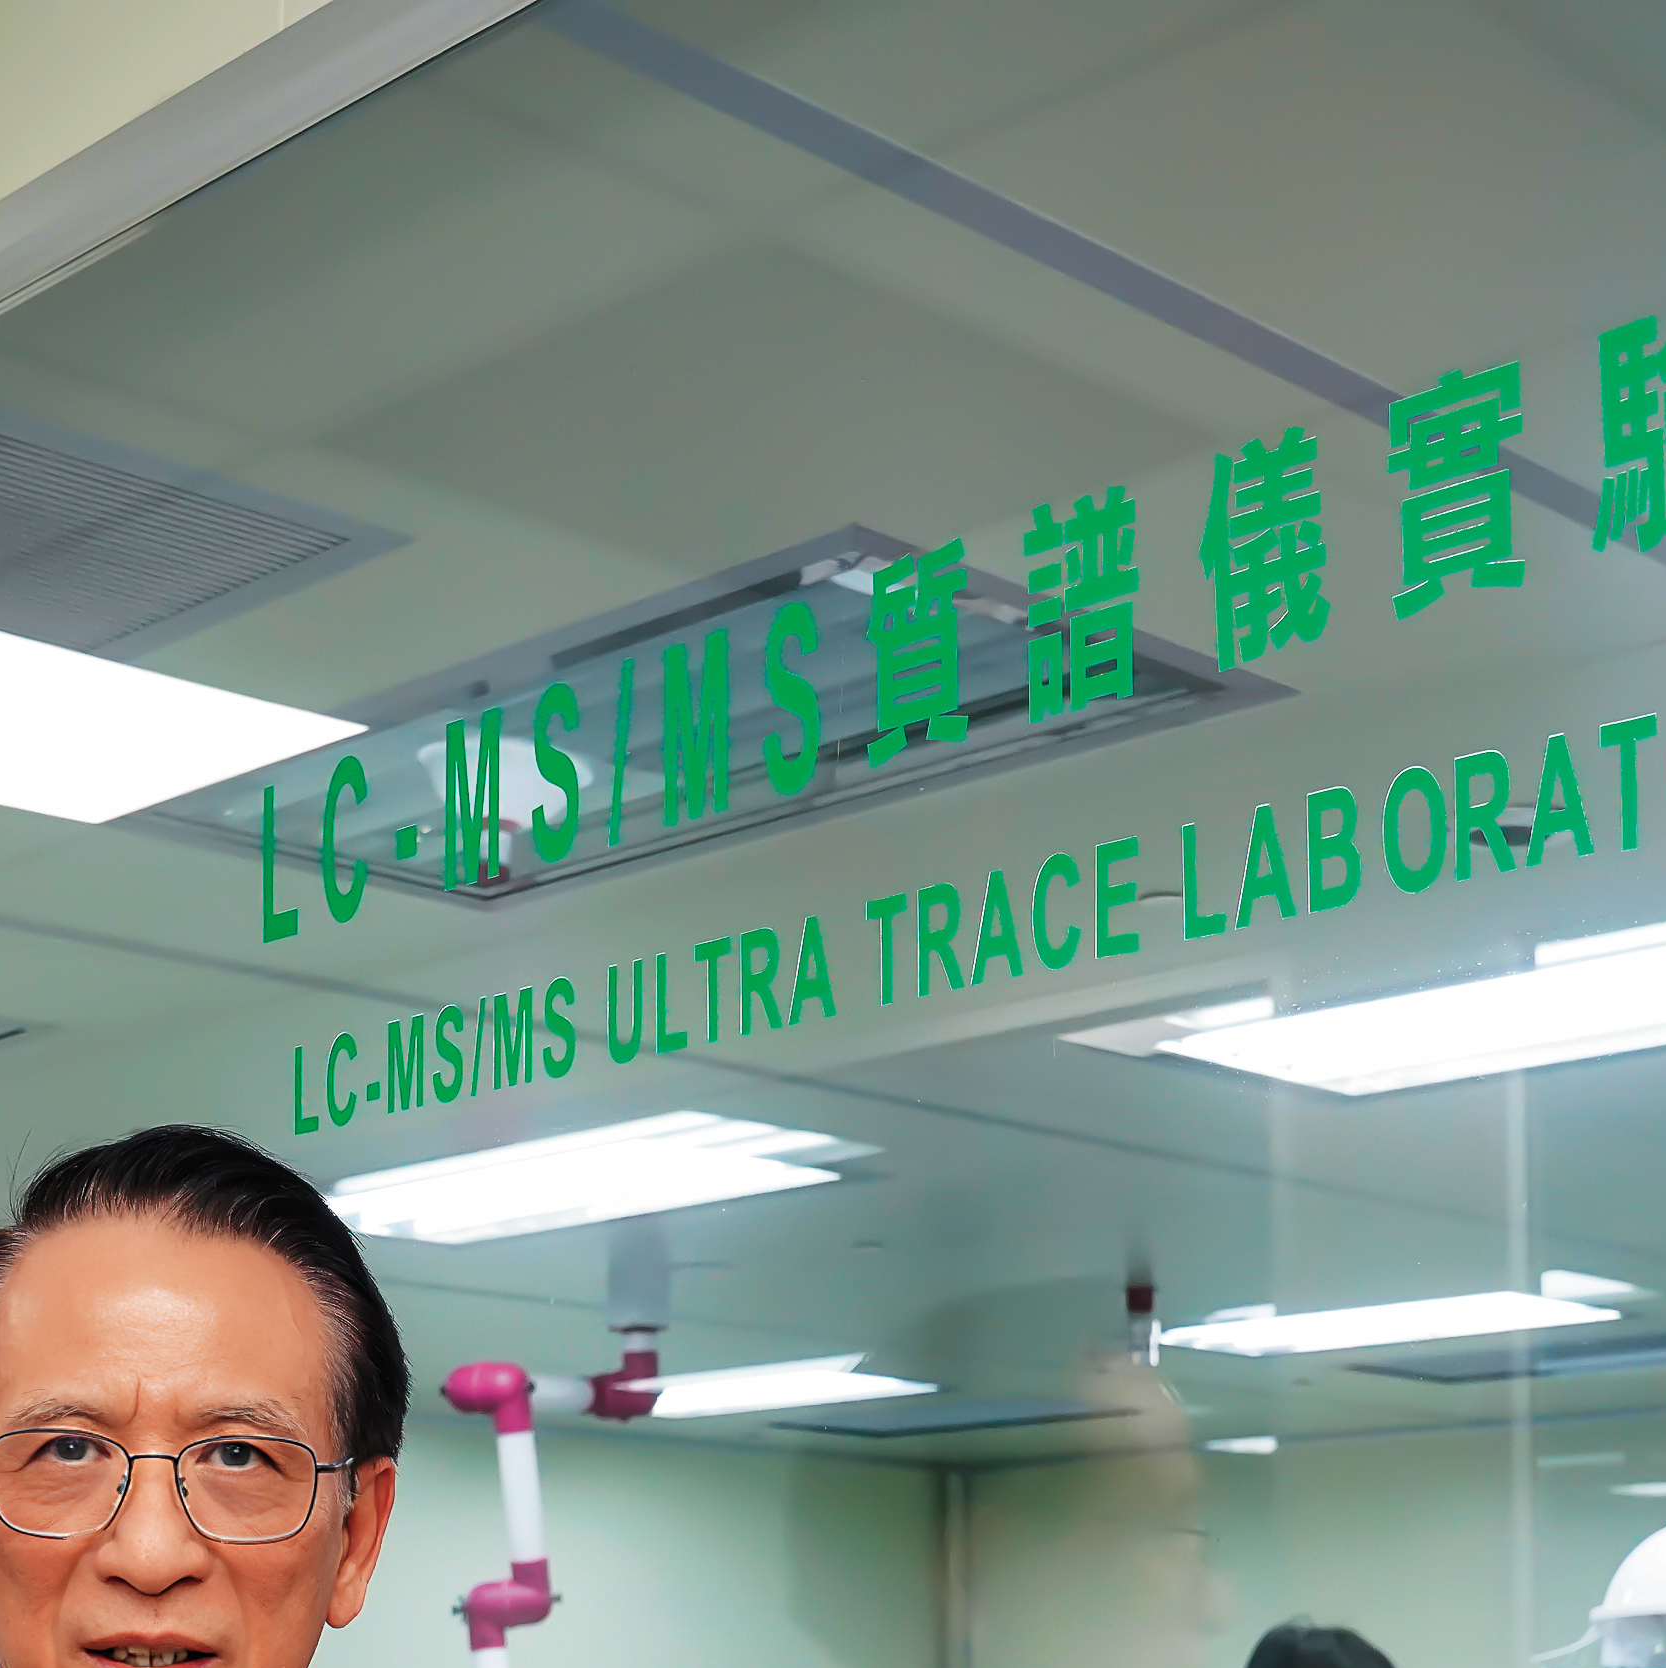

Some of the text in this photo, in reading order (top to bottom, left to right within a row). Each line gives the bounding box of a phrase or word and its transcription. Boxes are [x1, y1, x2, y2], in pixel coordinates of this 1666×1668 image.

[293, 978, 578, 1135] LC-MS/MS
[607, 916, 838, 1065] ULTRA
[866, 835, 1141, 1006] TRACE
